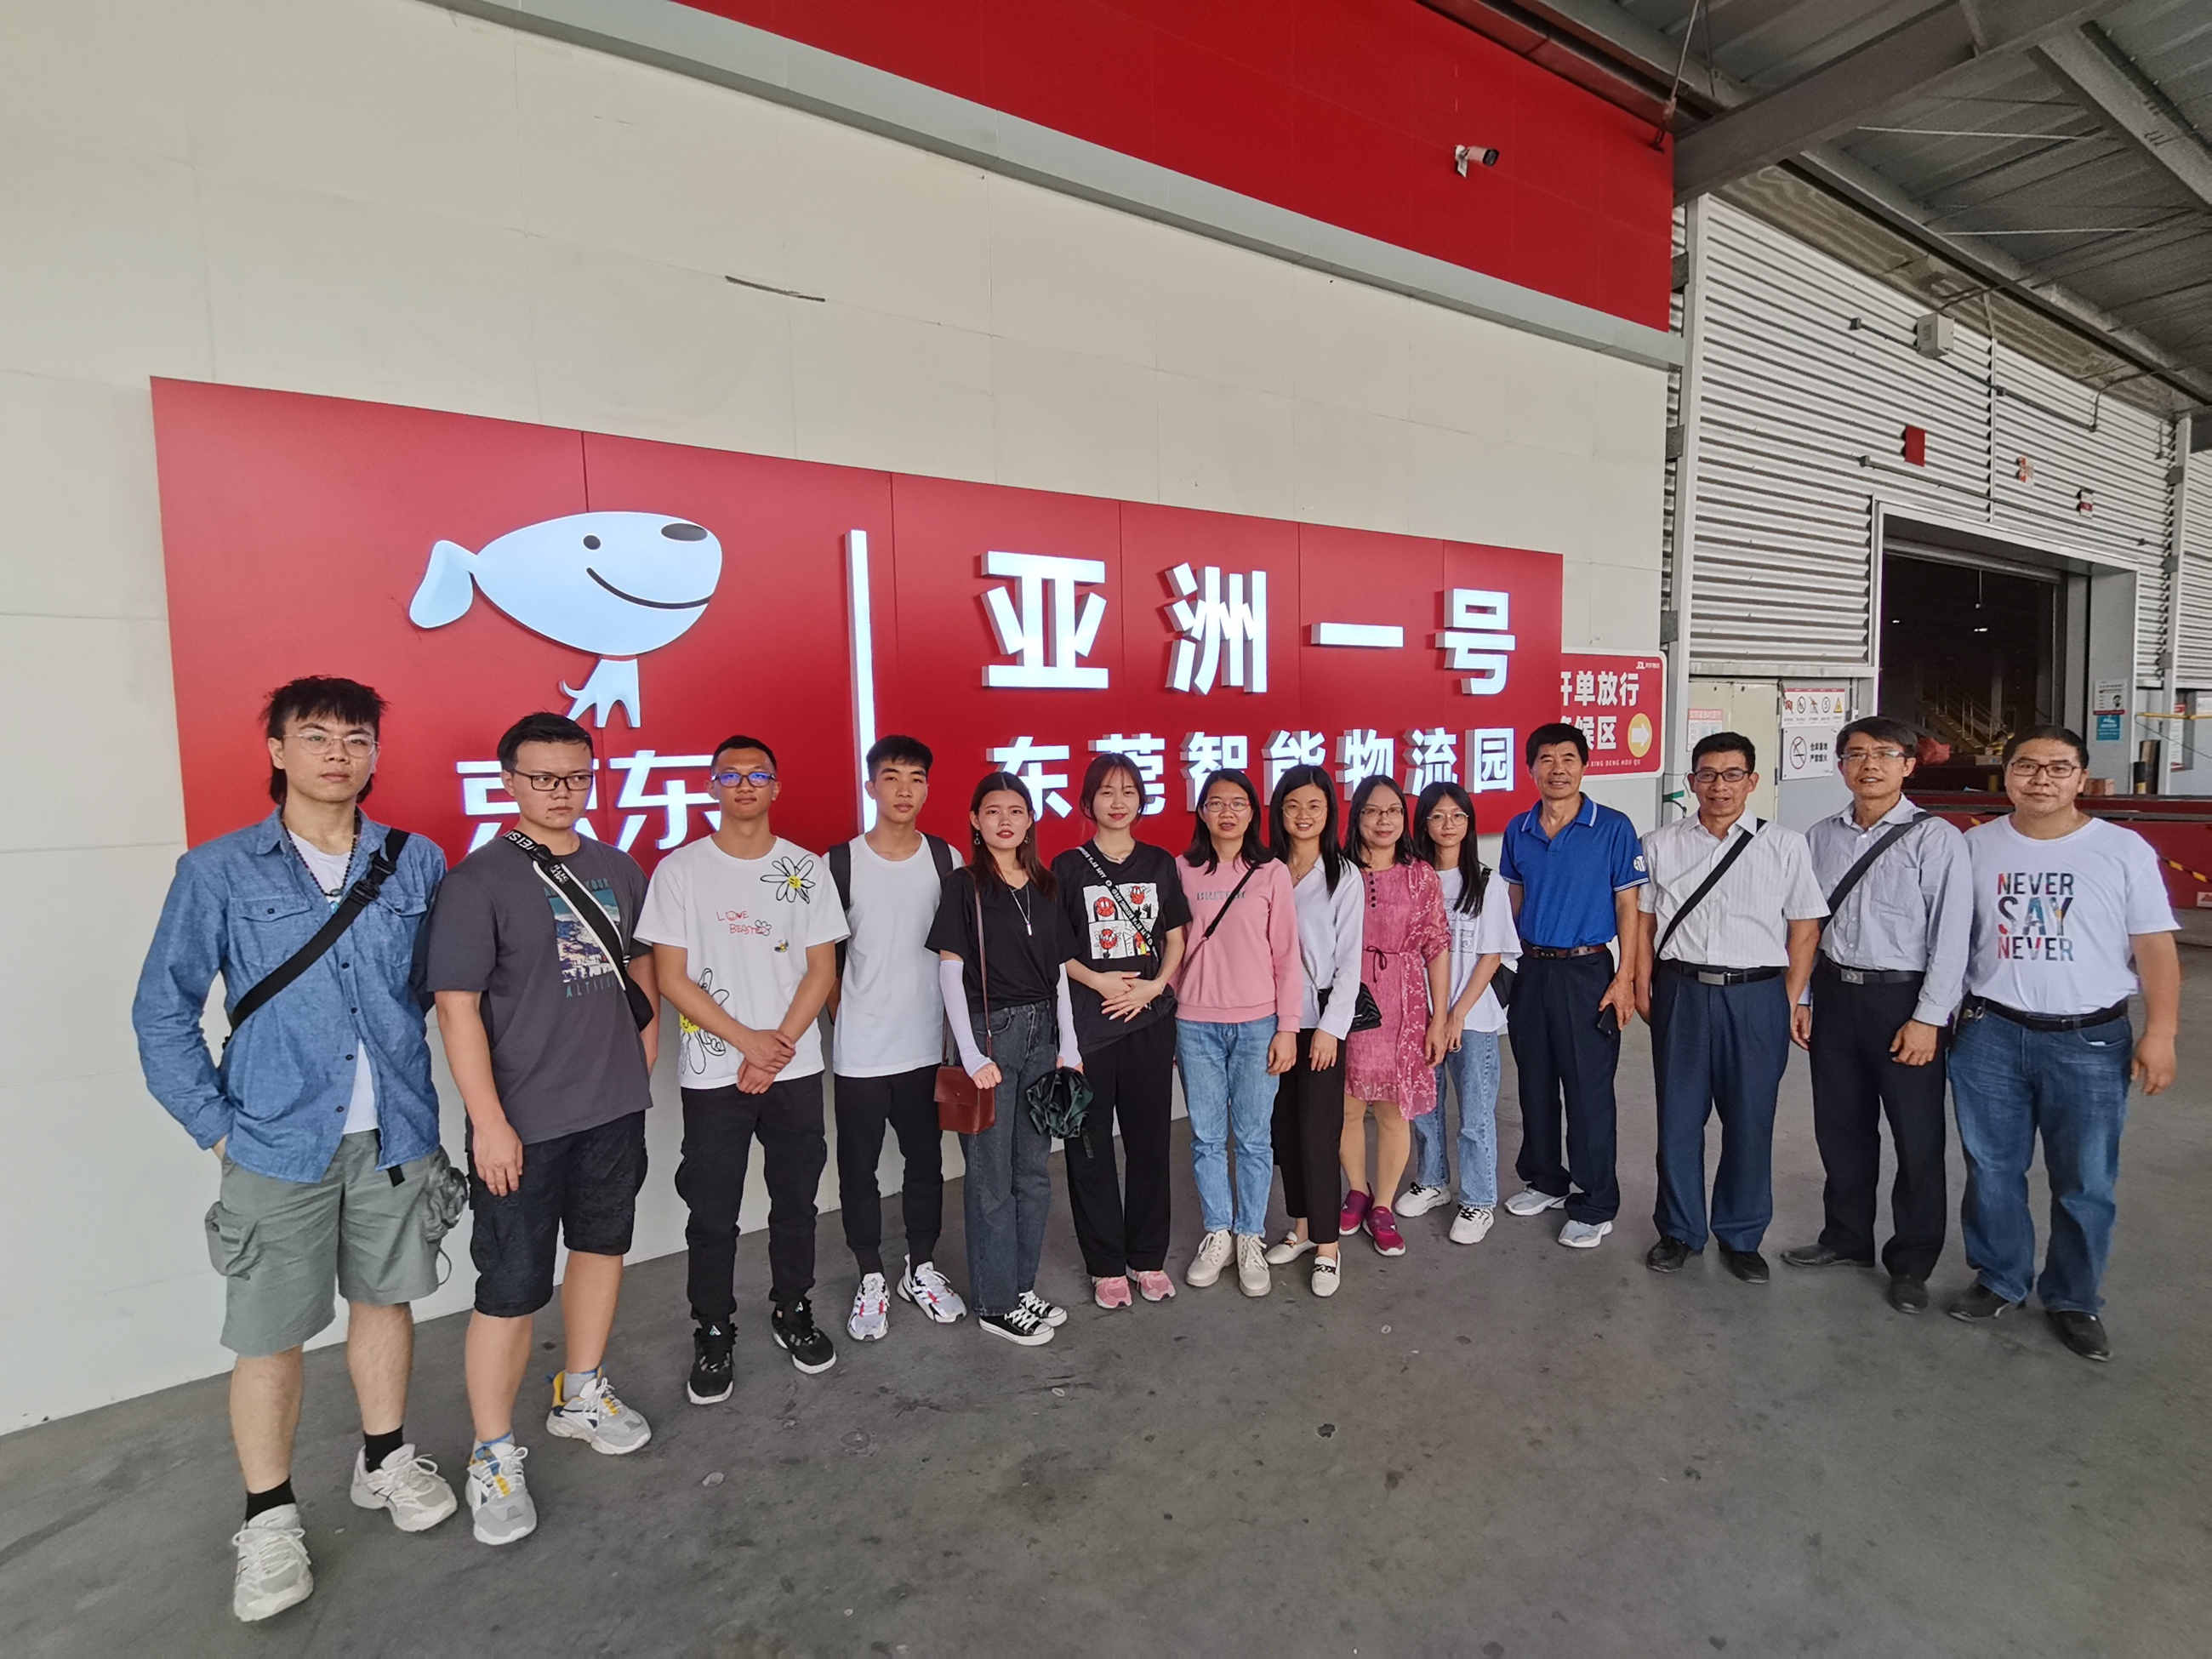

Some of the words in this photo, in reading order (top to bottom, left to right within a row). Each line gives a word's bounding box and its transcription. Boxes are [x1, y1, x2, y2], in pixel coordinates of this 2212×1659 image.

[981, 550, 1516, 695] 亚洲一号
[1633, 758, 1641, 767] QU
[1997, 872, 2074, 895] NEVER
[716, 910, 750, 921] LOVE
[1998, 896, 2073, 936] SAY
[1997, 936, 2074, 961] NEVER
